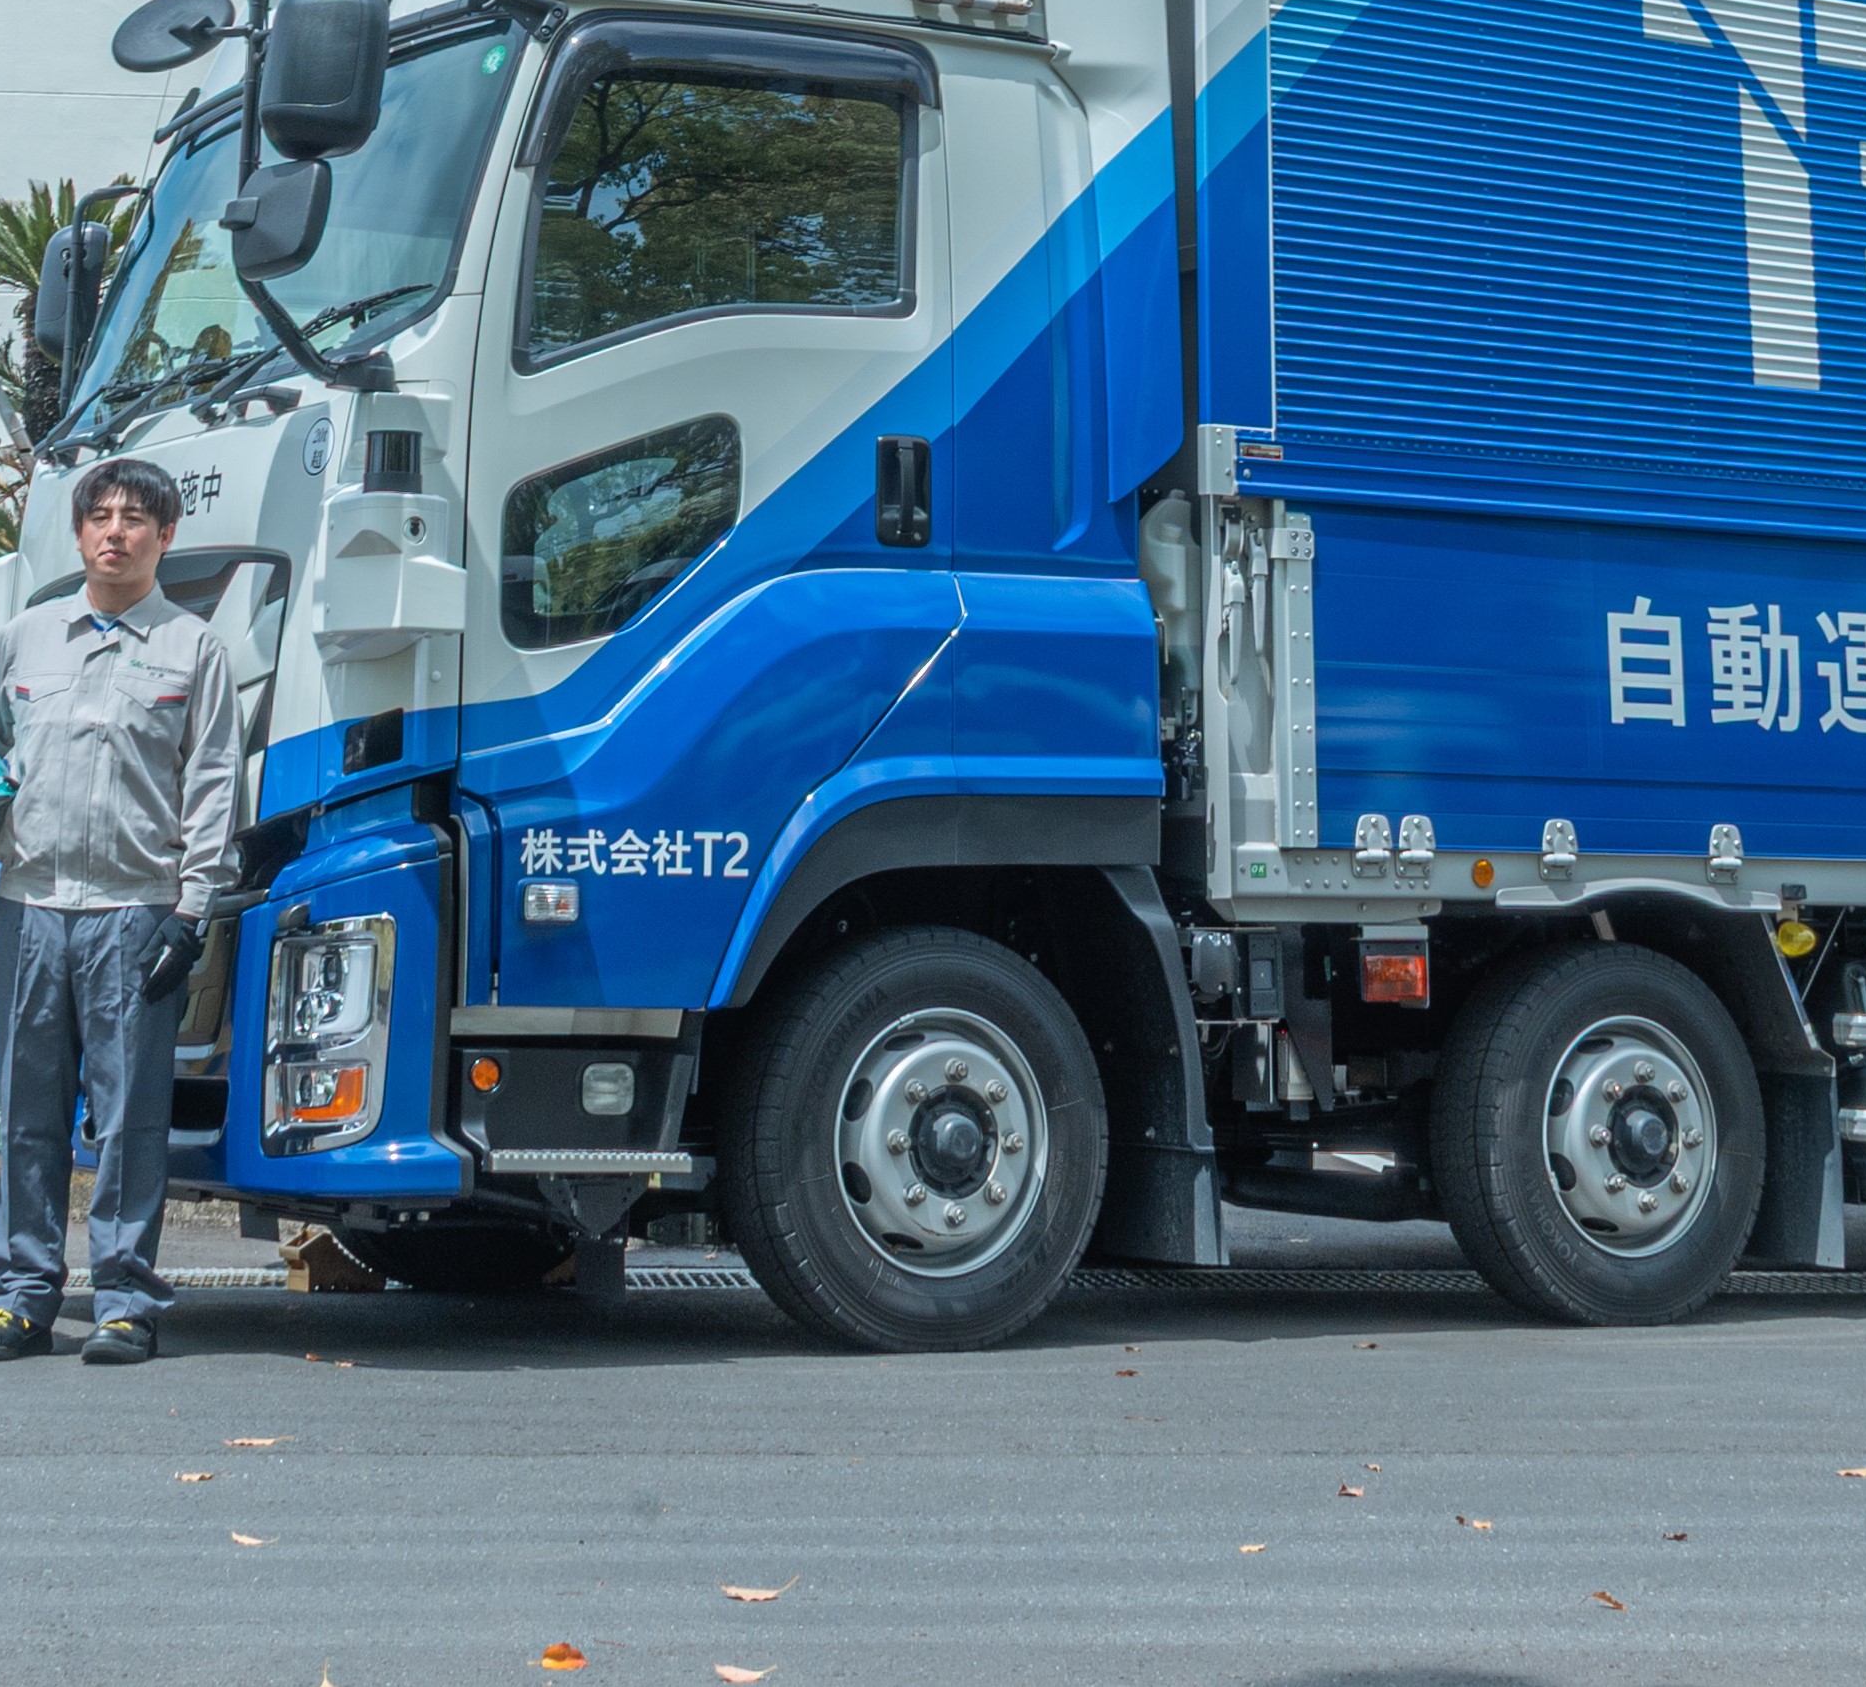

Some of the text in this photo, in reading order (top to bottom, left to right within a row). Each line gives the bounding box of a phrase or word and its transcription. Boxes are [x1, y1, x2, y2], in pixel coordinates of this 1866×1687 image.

[173, 465, 222, 516] 施中
[520, 828, 749, 877] 株式会社T2
[1251, 864, 1265, 874] OK
[1525, 1174, 1579, 1268] YOKOHAM
